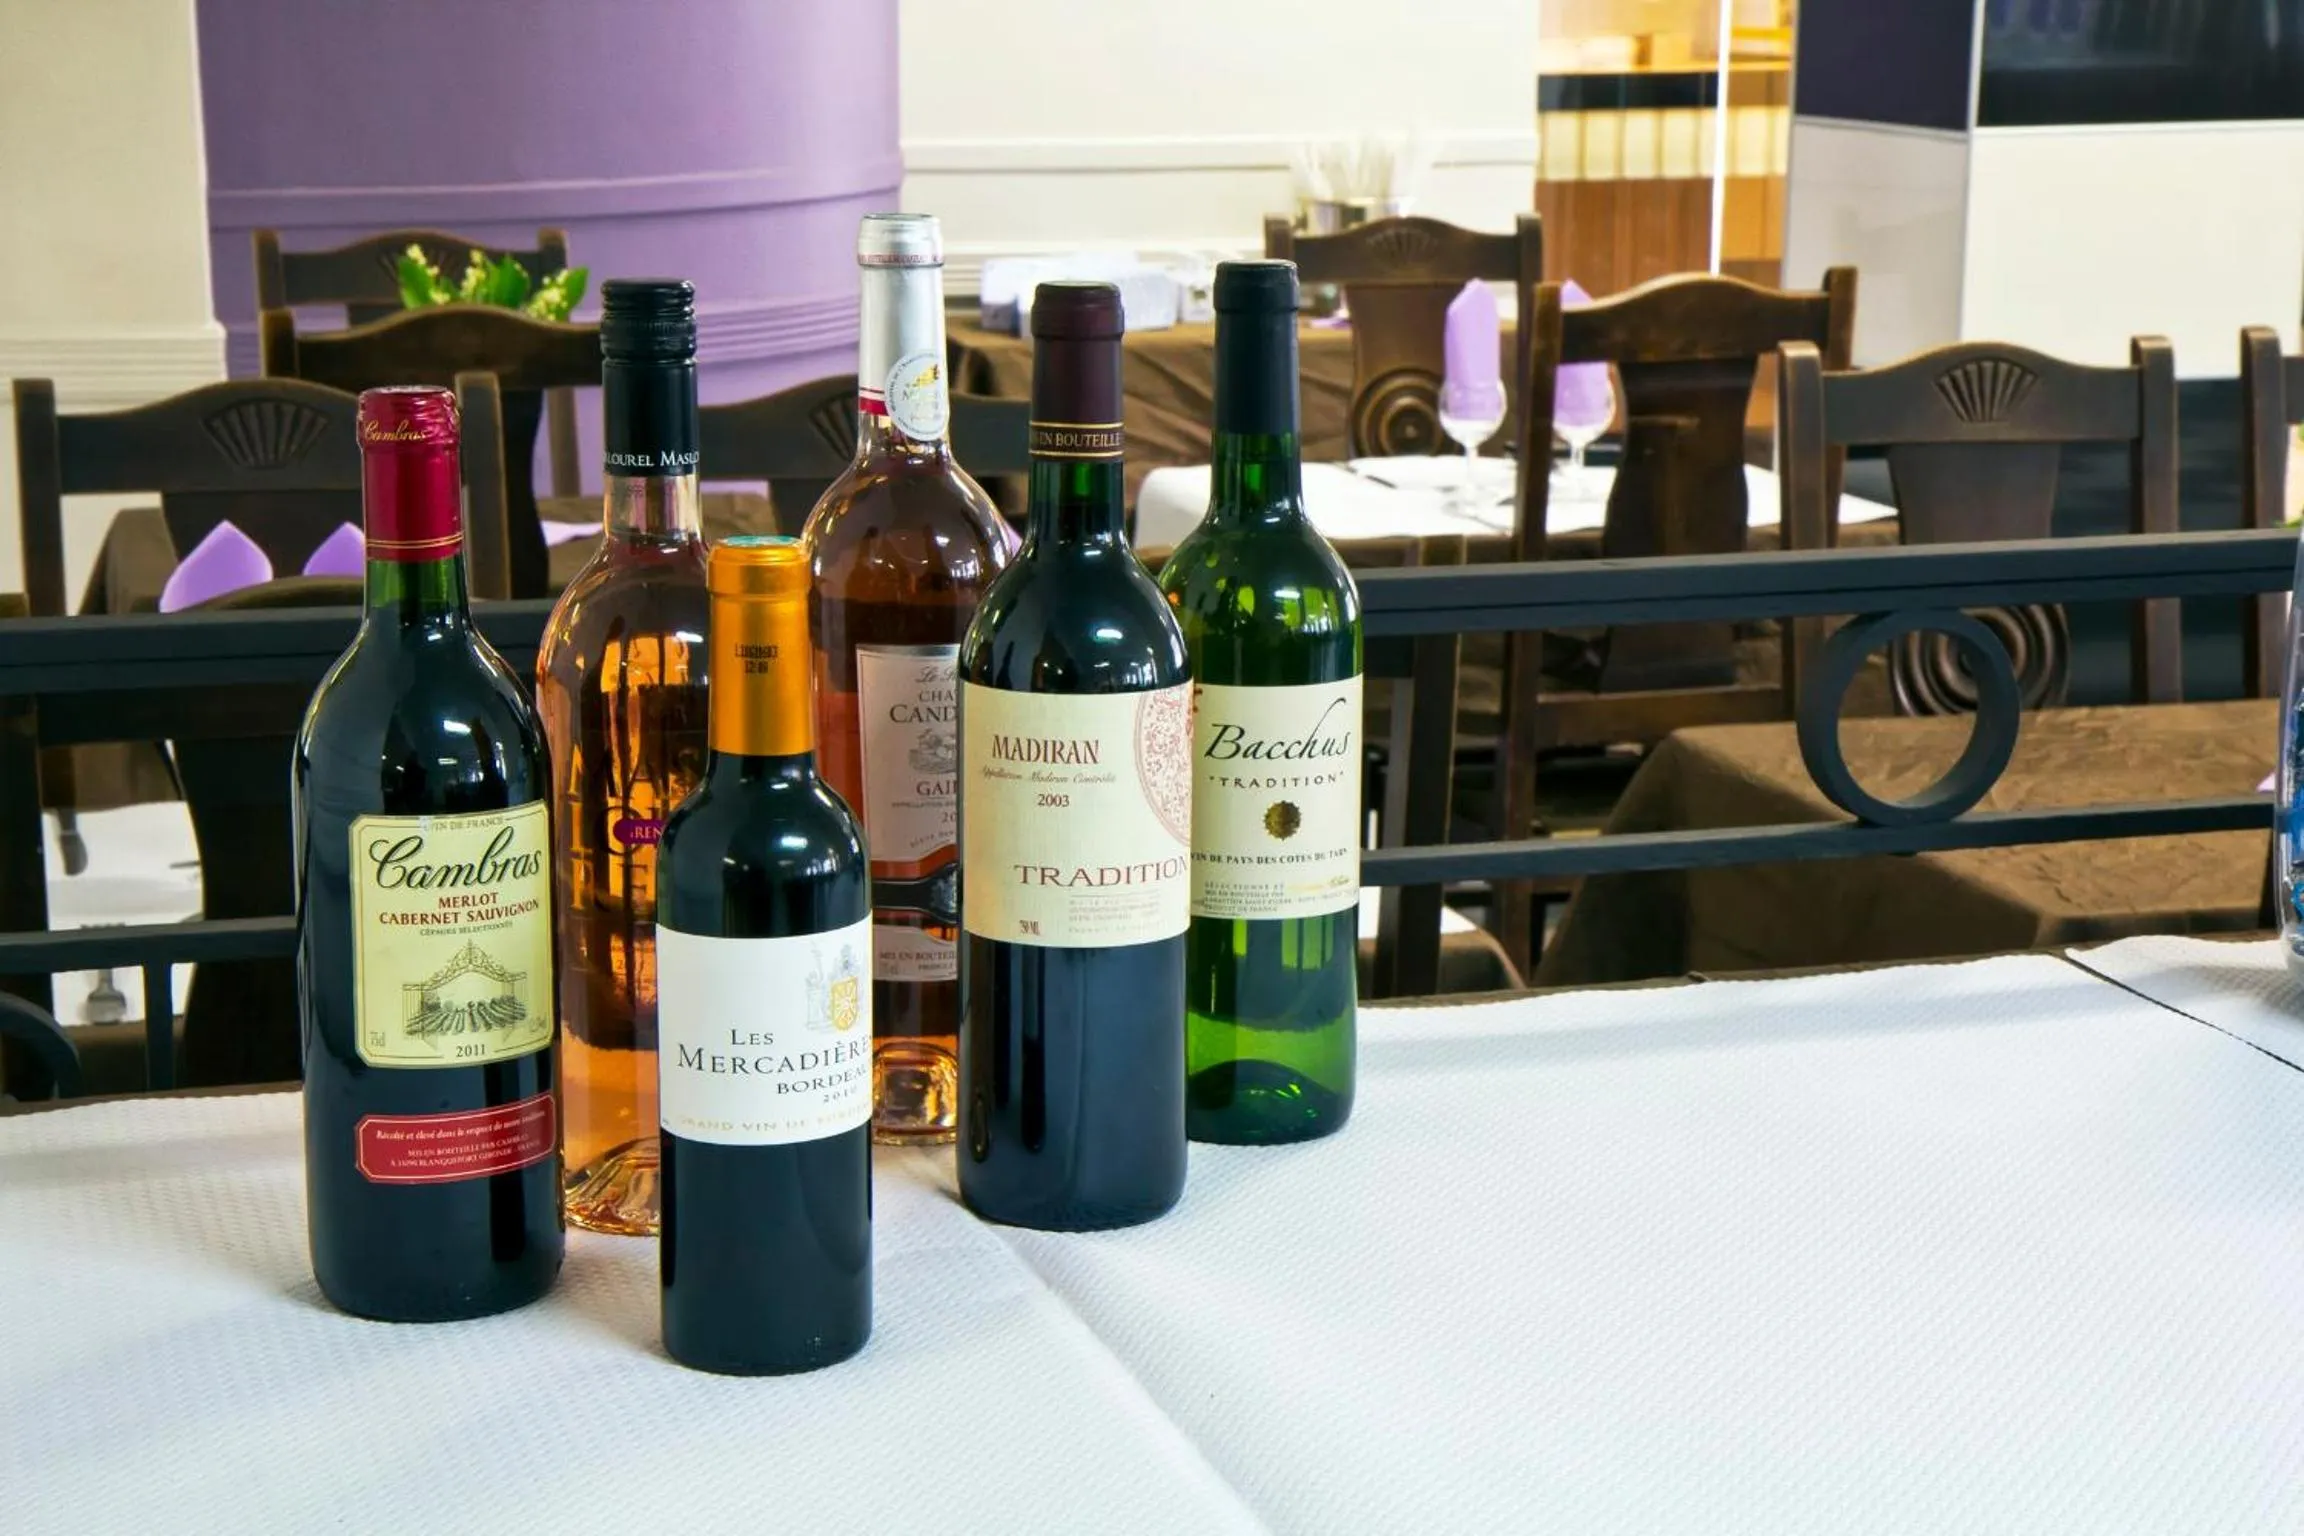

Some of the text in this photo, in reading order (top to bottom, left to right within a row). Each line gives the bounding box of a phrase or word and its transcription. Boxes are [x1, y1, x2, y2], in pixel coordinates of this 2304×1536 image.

[364, 419, 426, 441] Cambras
[1203, 697, 1351, 760] Bacchus
[991, 734, 1100, 764] MADIRAN
[1037, 793, 1070, 807] 2003
[449, 820, 463, 830] DE
[466, 816, 504, 828] FRANCE
[368, 825, 542, 890] Cambras
[1210, 854, 1222, 862] DE
[1227, 855, 1253, 864] PAYS
[1257, 856, 1276, 864] DES
[1014, 855, 1189, 888] TRADITION
[438, 892, 499, 909] MERLOT
[379, 899, 540, 926] CABERNET SAUVIGNON
[731, 1029, 774, 1045] LES
[455, 1044, 487, 1058] 2011
